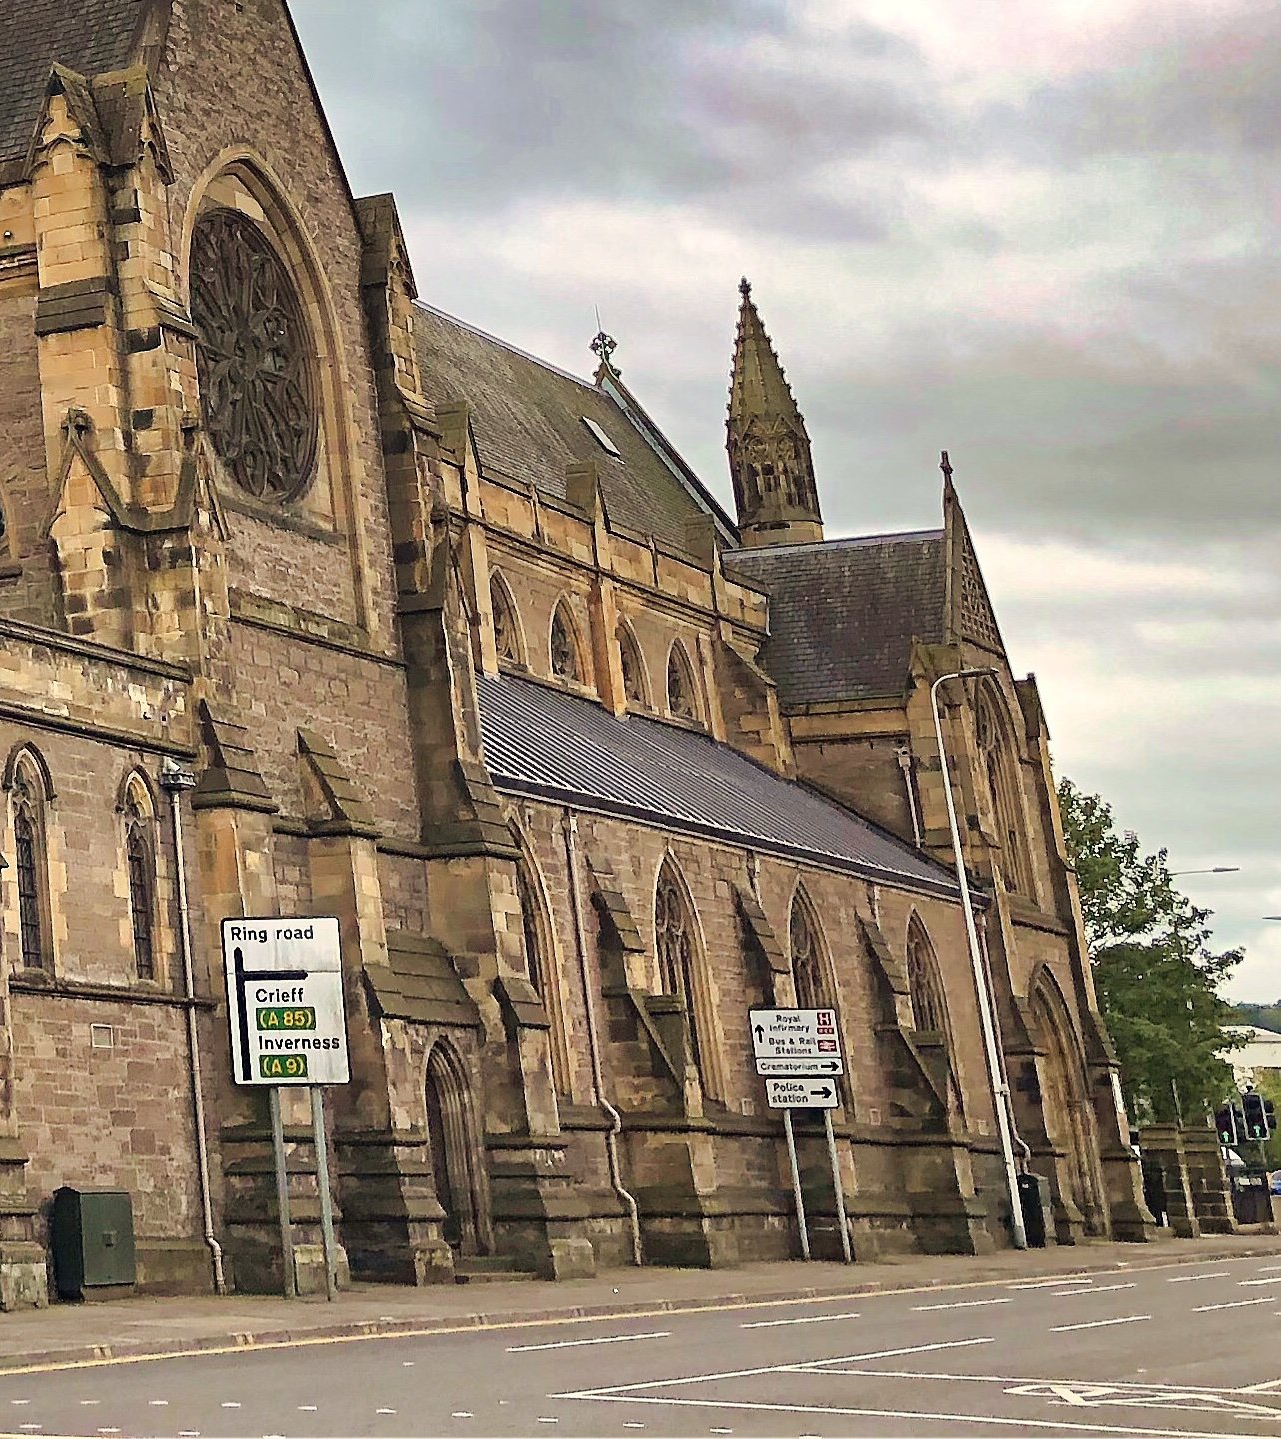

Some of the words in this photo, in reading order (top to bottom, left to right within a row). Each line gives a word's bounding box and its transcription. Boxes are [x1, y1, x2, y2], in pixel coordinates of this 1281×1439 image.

[230, 926, 268, 943] Ring
[276, 926, 314, 940] road
[255, 988, 304, 1003] Crieff
[776, 1015, 800, 1024] Royal
[770, 1024, 810, 1033] Infirmary
[259, 1036, 340, 1050] Inverness
[799, 1037, 816, 1045] Rail
[761, 1063, 818, 1071] Crematorium
[773, 1082, 804, 1092] Police
[772, 1095, 808, 1103] station
